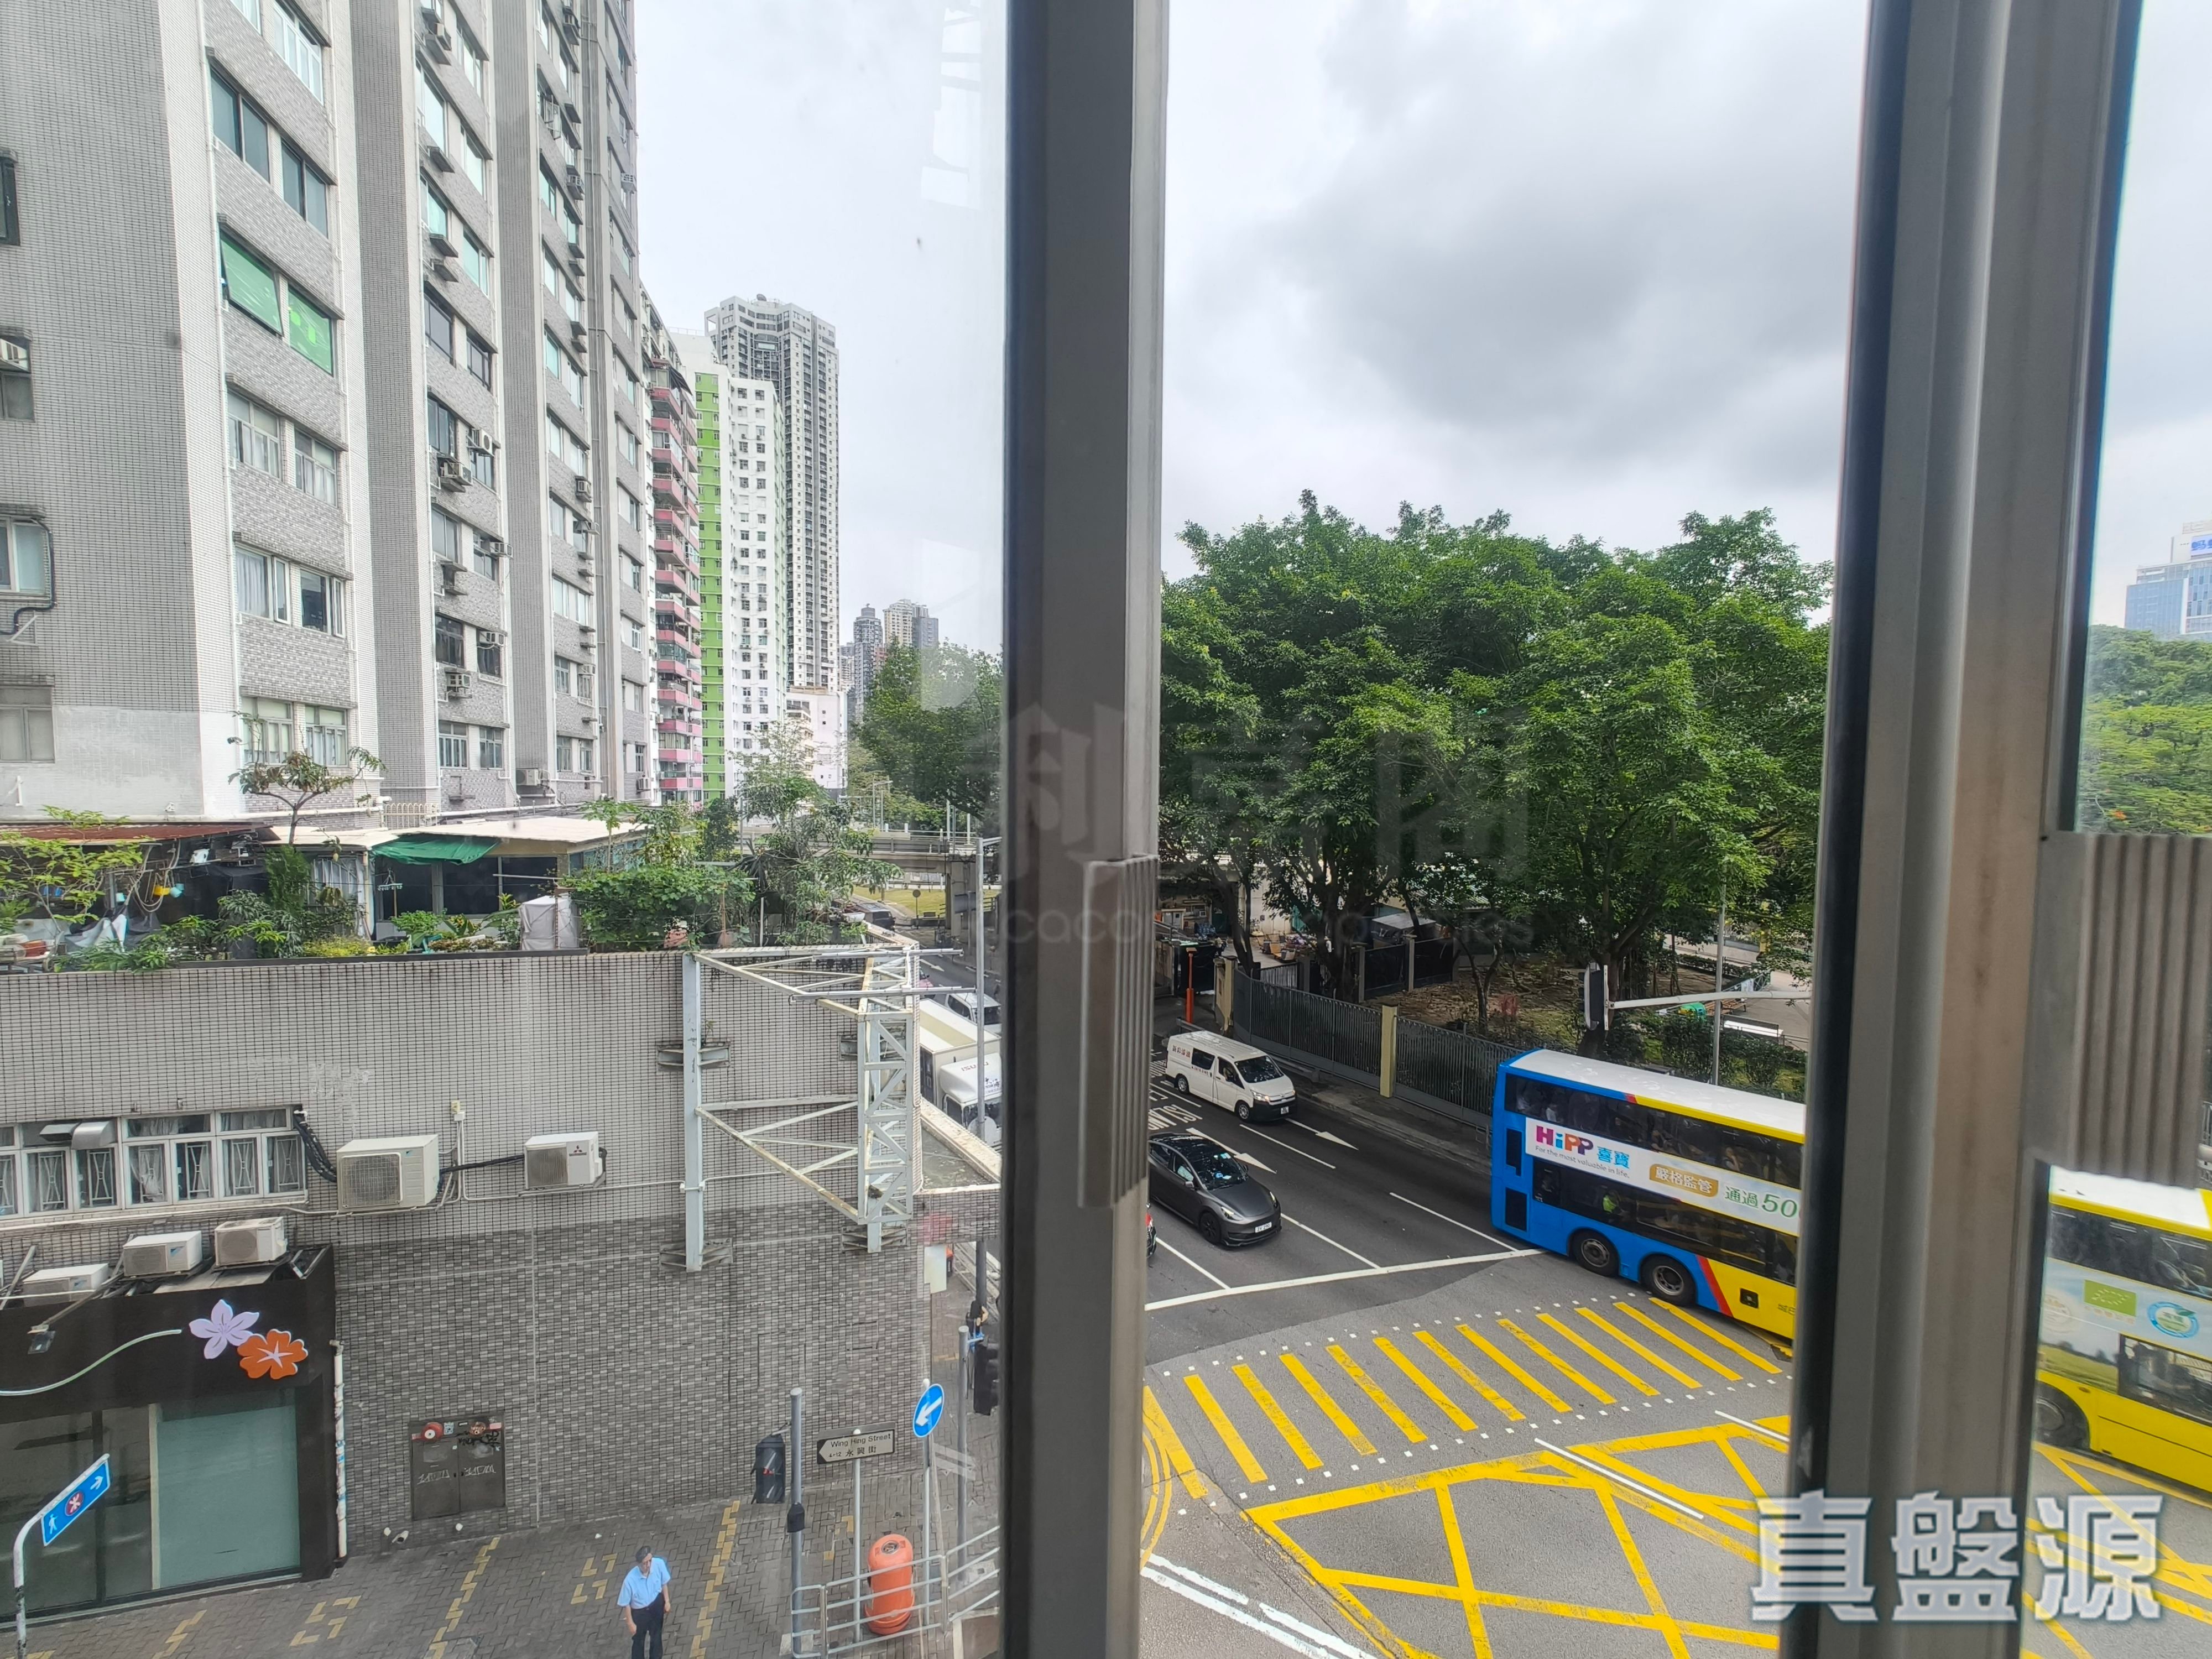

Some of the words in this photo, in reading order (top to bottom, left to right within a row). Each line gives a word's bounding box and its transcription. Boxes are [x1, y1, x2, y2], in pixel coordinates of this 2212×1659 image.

[961, 1061, 989, 1071] ISUU
[1536, 1125, 1594, 1155] HiPP
[1597, 1146, 1630, 1169] 喜寶
[1535, 1145, 1545, 1154] For
[1547, 1148, 1559, 1157] the
[1559, 1153, 1576, 1163] most
[1577, 1158, 1607, 1172] valuable
[1655, 1166, 1713, 1194] 嚴格監管
[868, 1433, 891, 1442] Street
[845, 1446, 877, 1457] 永興街
